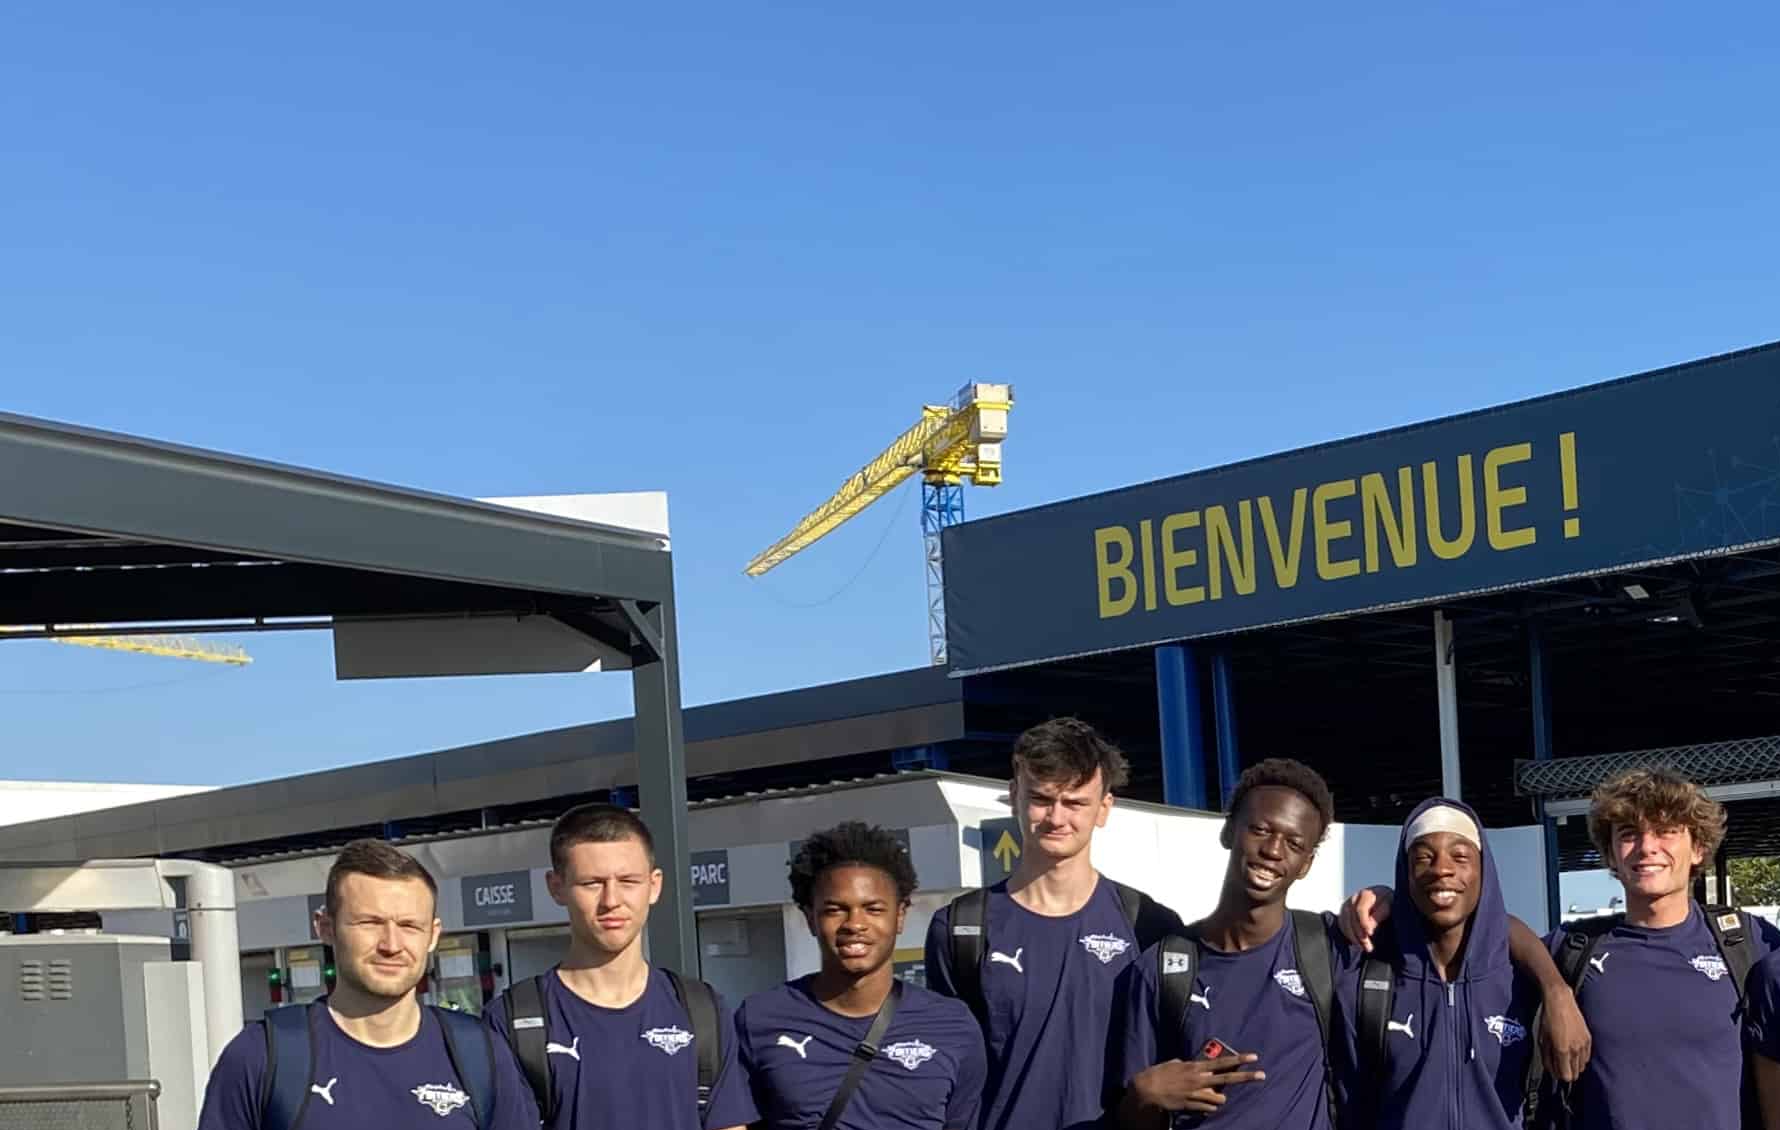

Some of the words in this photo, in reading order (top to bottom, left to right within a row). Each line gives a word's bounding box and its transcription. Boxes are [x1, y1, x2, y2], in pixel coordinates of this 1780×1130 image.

[1093, 441, 1537, 619] BIENVENUE
[1558, 431, 1582, 538] !
[690, 863, 727, 886] PARC
[475, 882, 516, 907] CAISSE
